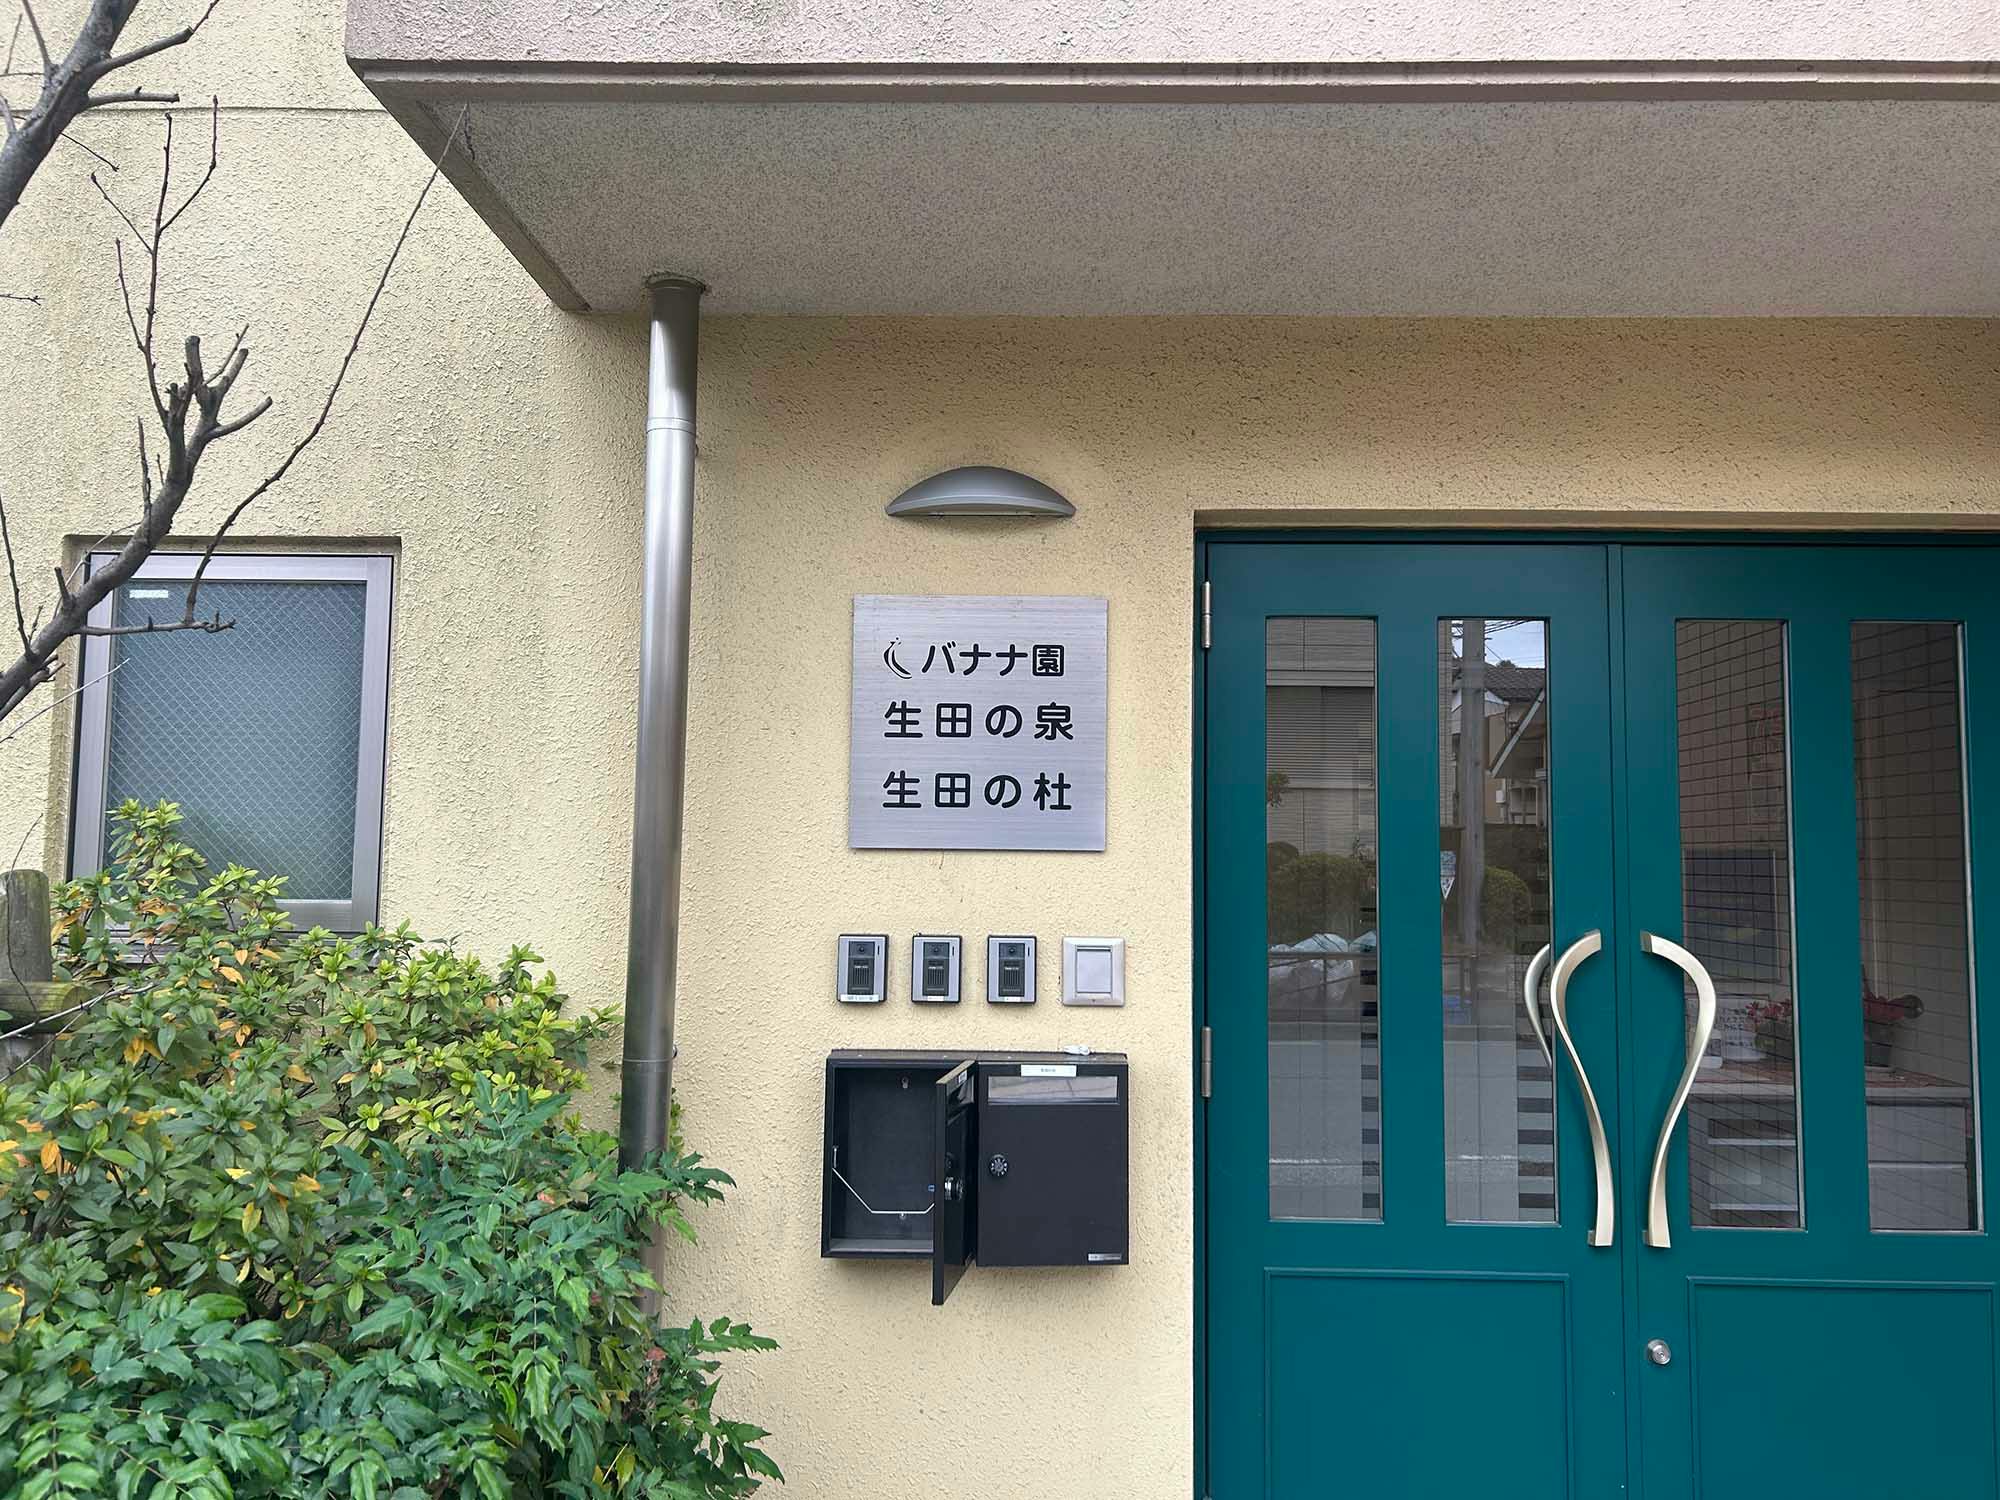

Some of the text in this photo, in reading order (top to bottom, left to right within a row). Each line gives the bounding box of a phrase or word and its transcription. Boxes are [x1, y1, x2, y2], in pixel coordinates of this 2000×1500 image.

[922, 641, 1065, 677] バナナ園
[884, 700, 1074, 740] 生田の泉
[882, 770, 1072, 811] 生田の杜
